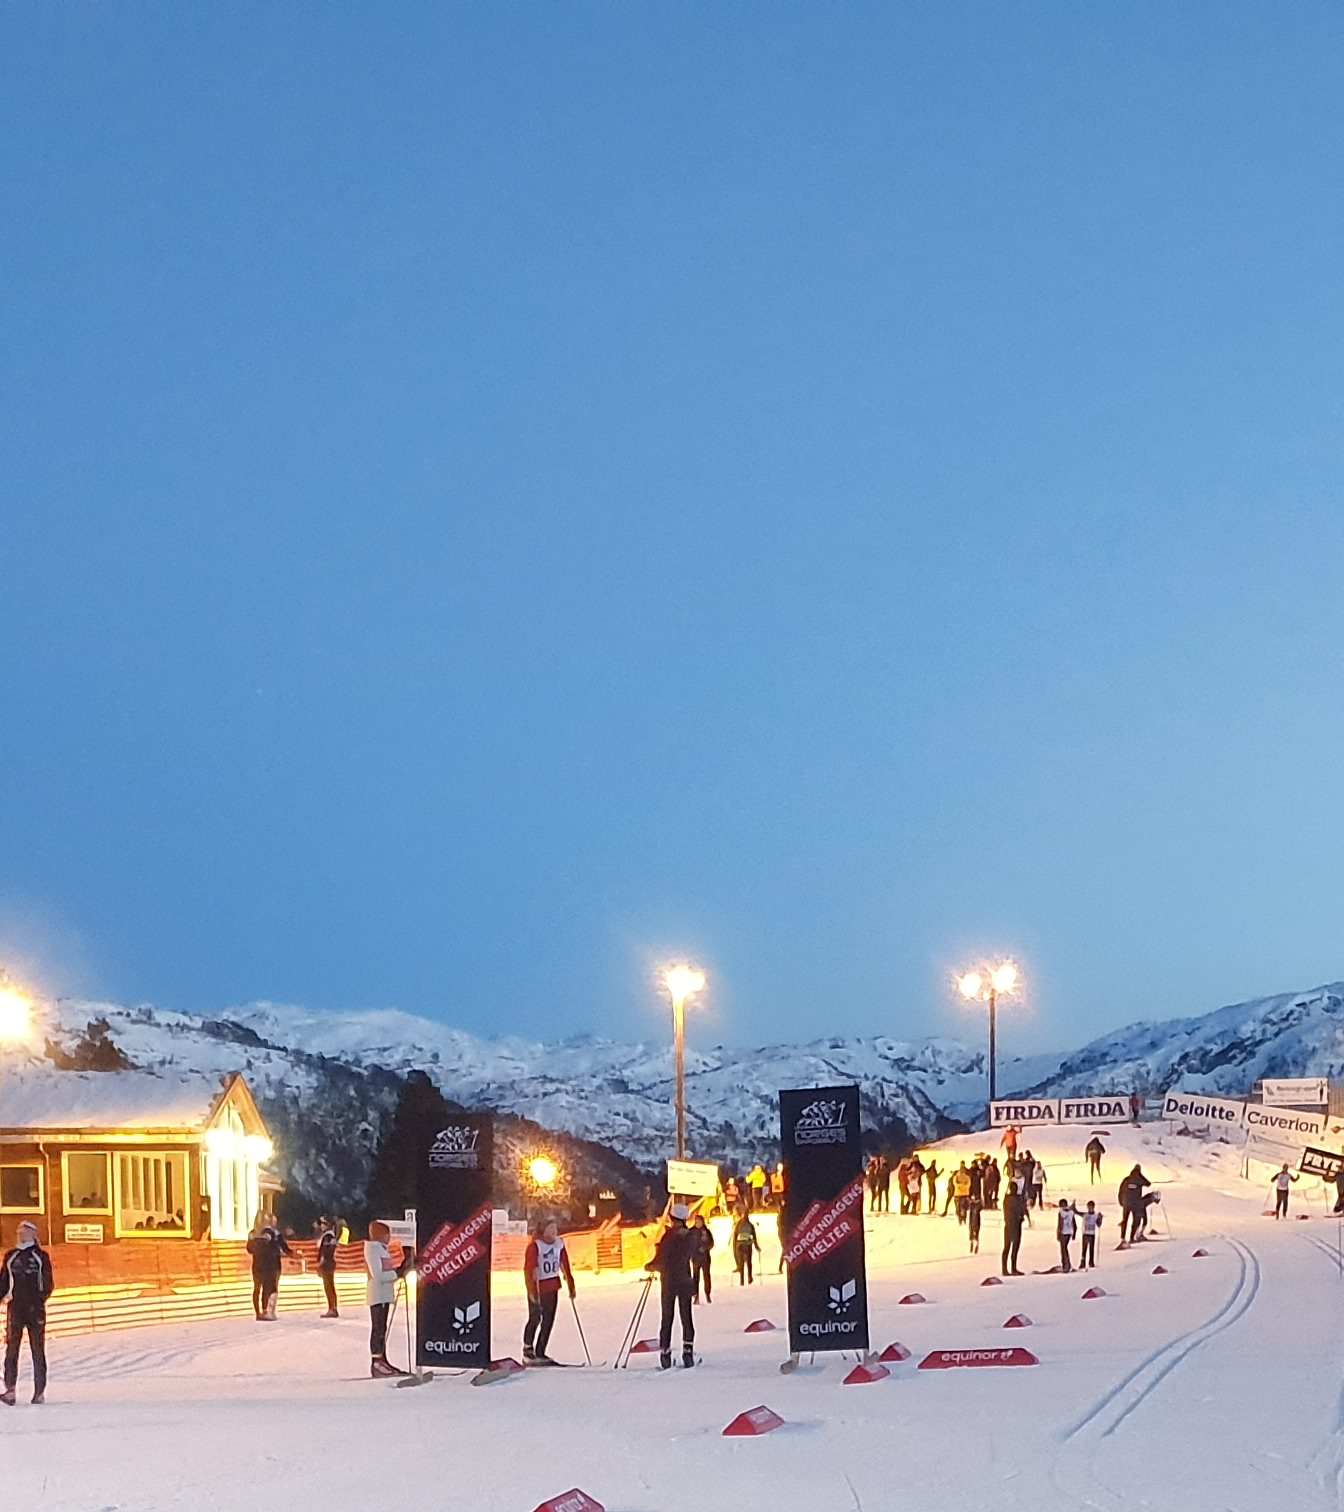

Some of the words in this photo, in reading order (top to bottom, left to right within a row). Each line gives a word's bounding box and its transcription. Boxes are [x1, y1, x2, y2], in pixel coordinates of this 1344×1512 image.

[994, 1104, 1054, 1121] FIRDA
[1064, 1102, 1126, 1119] FIRDA
[1247, 1111, 1320, 1135] Caverion
[783, 1184, 863, 1263] MORGENDAGENS
[417, 1209, 492, 1281] MORGENDAGENS
[808, 1221, 851, 1260] HELTER
[437, 1245, 479, 1281] HELTER
[800, 1320, 858, 1336] equinor
[425, 1339, 480, 1355] equinor
[941, 1350, 997, 1363] equinor
